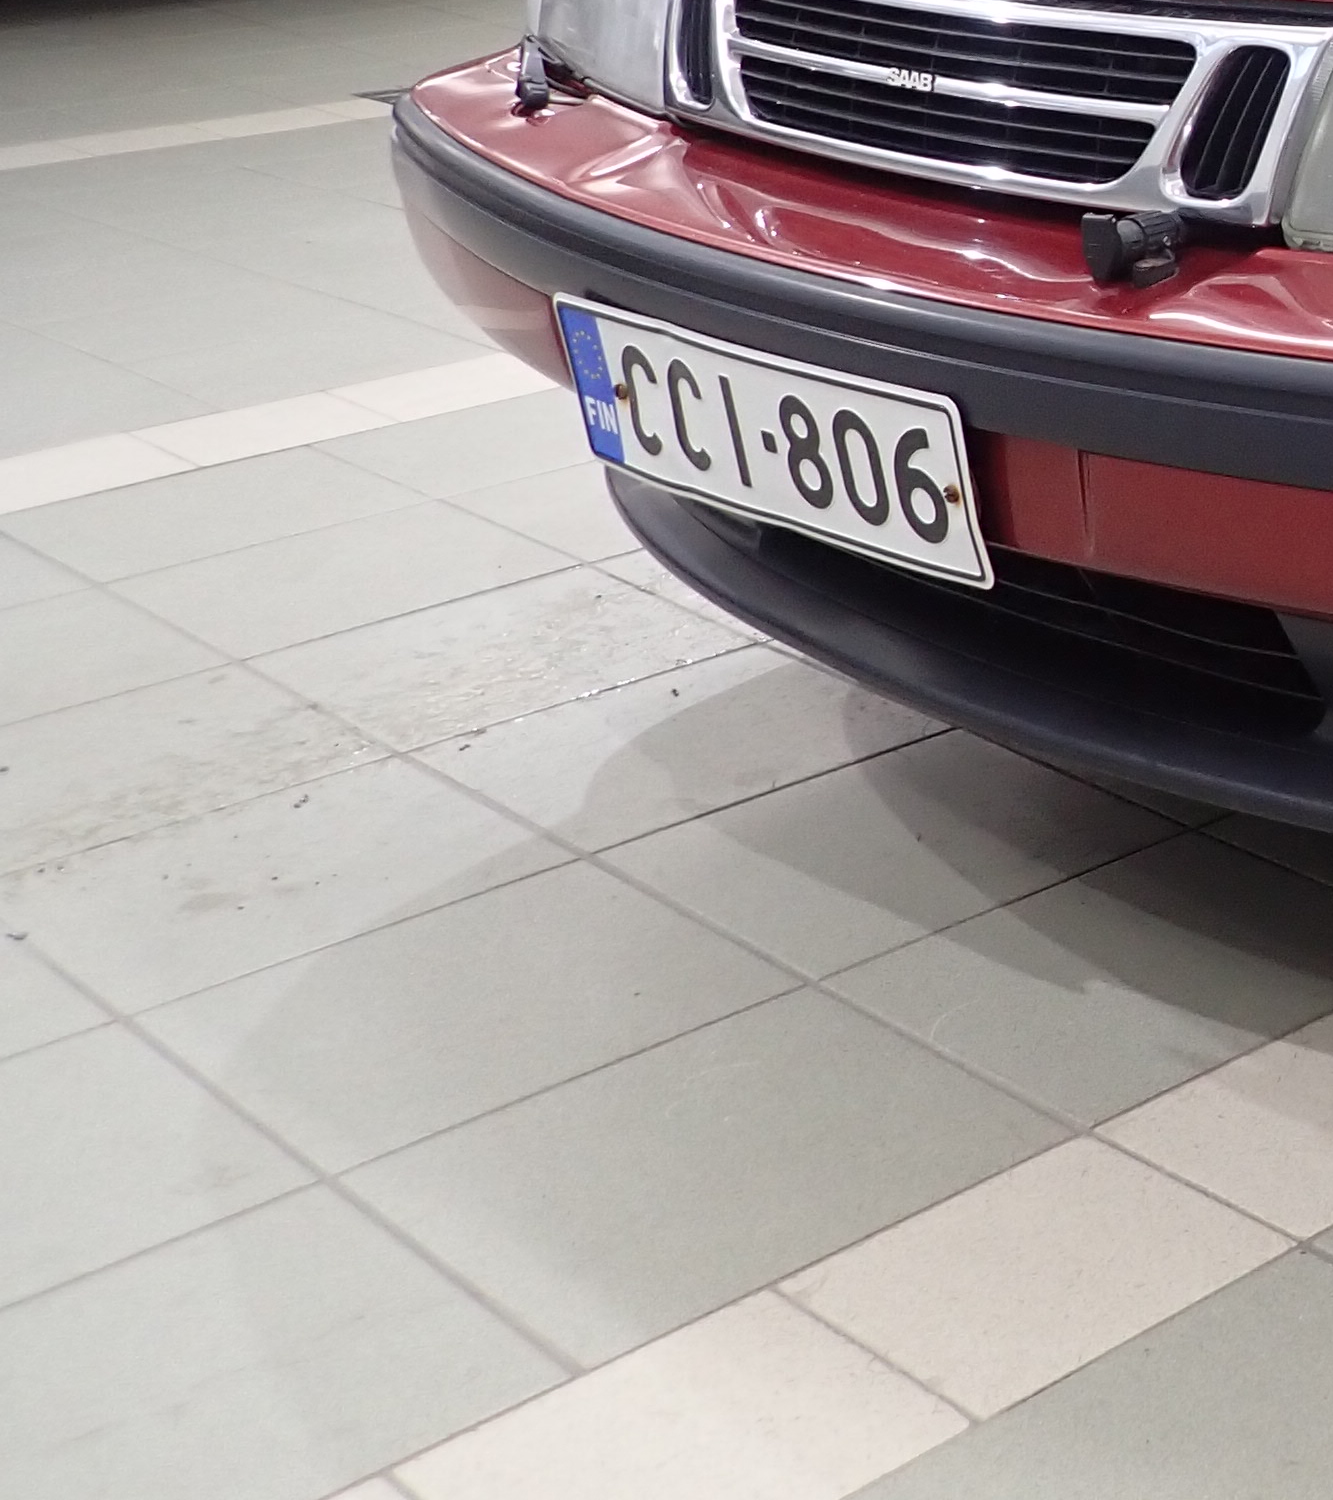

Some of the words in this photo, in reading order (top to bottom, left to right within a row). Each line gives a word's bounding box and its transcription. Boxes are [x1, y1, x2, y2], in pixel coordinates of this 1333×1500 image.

[886, 67, 932, 92] SAAB
[585, 396, 619, 436] FIN
[621, 345, 949, 544] CCI-806
